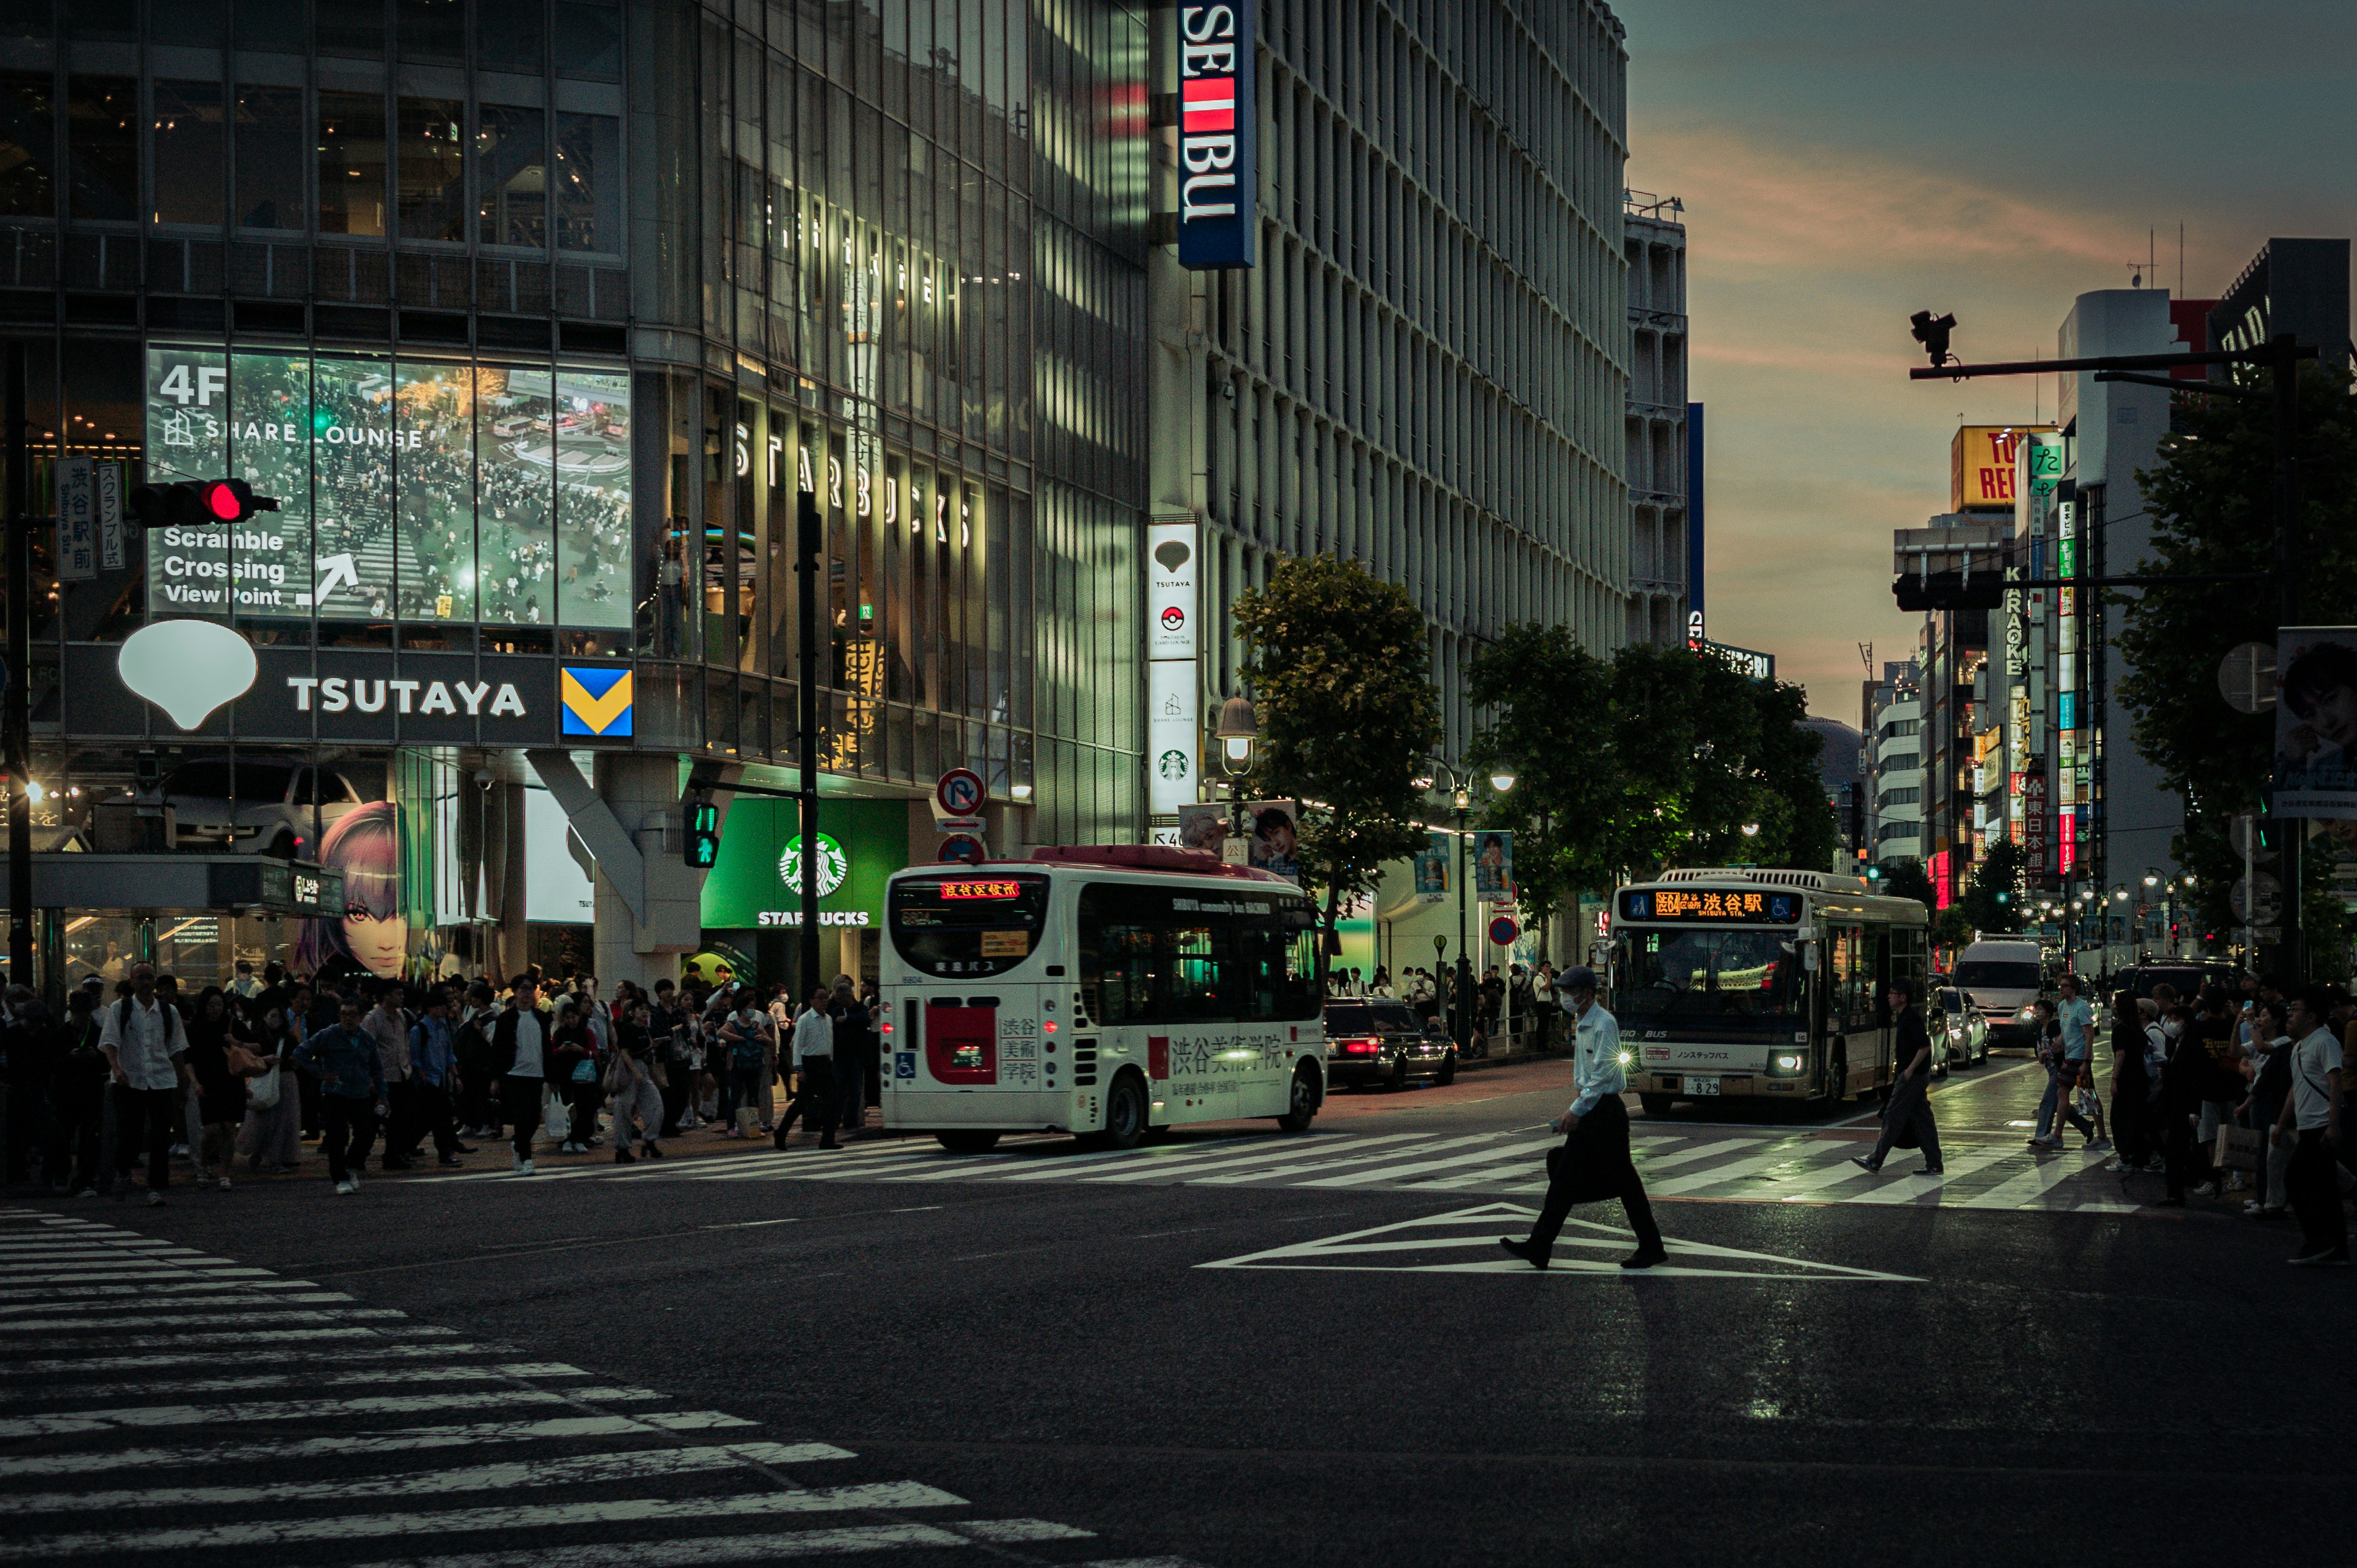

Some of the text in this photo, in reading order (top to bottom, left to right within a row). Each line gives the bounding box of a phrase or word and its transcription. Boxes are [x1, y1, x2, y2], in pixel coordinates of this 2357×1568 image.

[1182, 4, 1236, 225] SEIBU
[160, 365, 226, 406] 4F
[205, 420, 297, 443] SHARE
[62, 484, 70, 531] Shibuya
[72, 467, 90, 570] 渋谷駅前
[103, 468, 118, 565] スクランブル式
[164, 528, 283, 550] Scramble
[164, 556, 285, 584] Crossing
[165, 584, 281, 605] View Point
[2006, 566, 2022, 675] KARAOKE
[287, 677, 526, 716] TSUTAYA
[2017, 695, 2033, 772] カラオケ
[2027, 800, 2043, 885] 東日本銀行
[758, 912, 869, 926] STAUCKS
[1704, 893, 1762, 912] 渋谷駅
[1003, 1018, 1035, 1035] 渋谷
[1003, 1063, 1036, 1079] 学院
[1172, 1036, 1281, 1075] 渋谷美術学院
